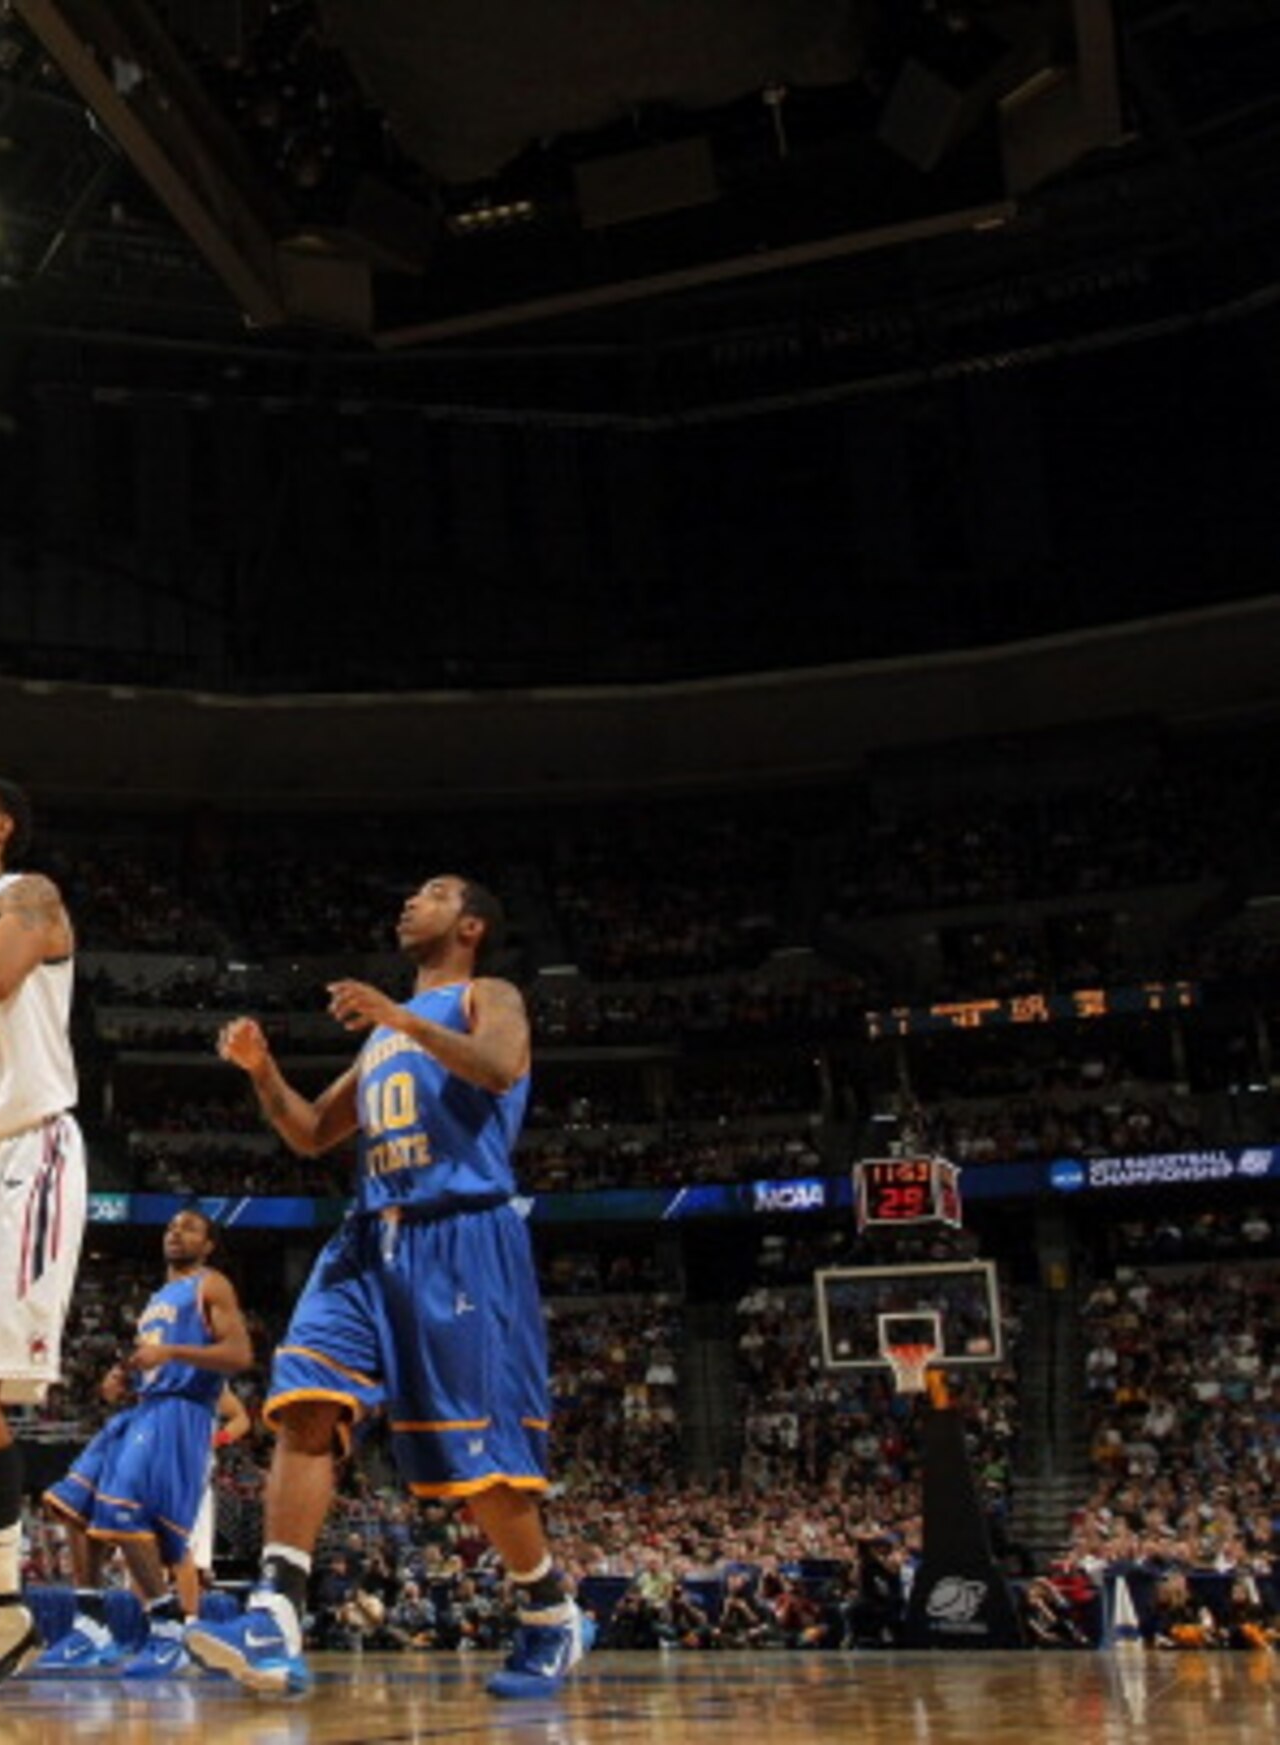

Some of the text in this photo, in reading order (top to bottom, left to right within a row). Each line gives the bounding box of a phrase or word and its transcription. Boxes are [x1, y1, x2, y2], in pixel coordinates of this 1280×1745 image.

[365, 1071, 417, 1138] 10
[1090, 1159, 1234, 1187] CHAMPIONSHIP
[754, 1183, 825, 1212] NCAA
